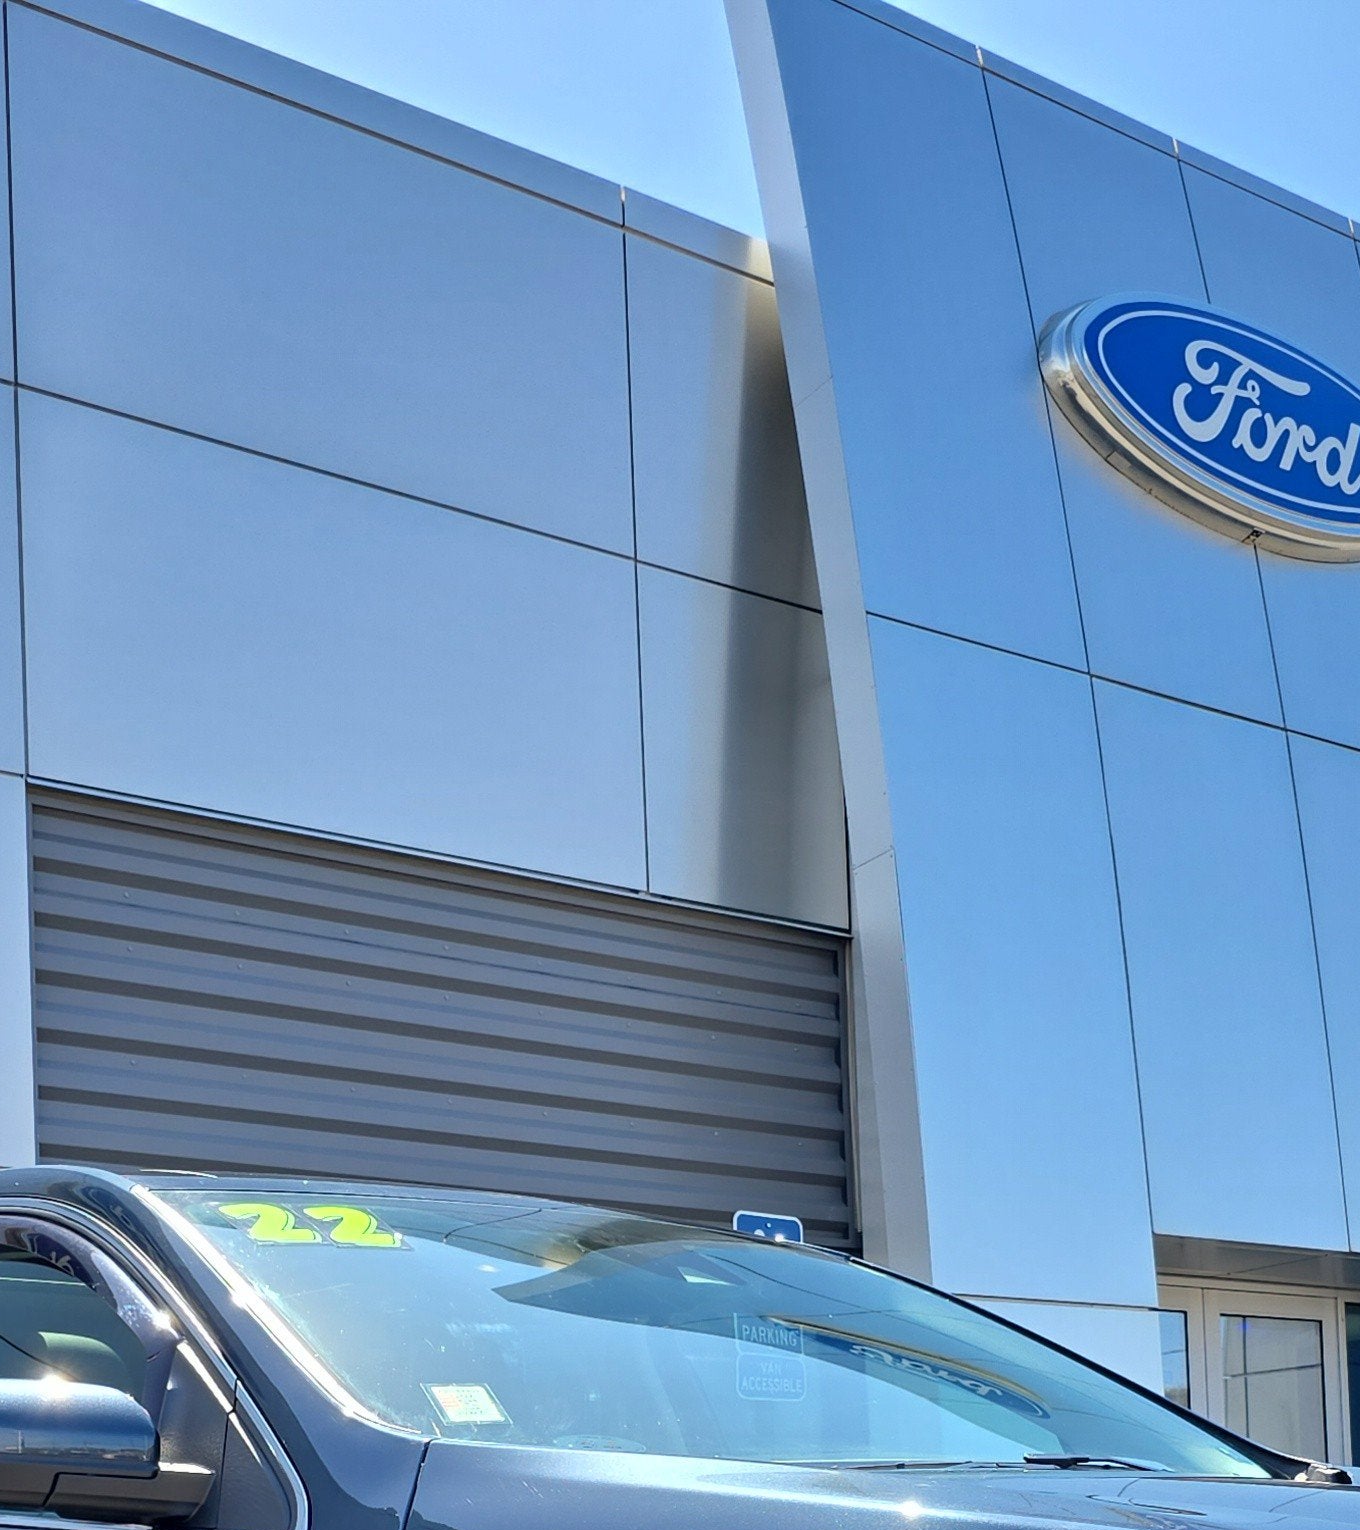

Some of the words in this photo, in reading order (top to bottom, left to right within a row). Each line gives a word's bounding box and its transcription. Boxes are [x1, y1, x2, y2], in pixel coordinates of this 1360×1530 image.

[218, 1203, 402, 1247] 22
[741, 1324, 799, 1347] PARKING
[760, 1362, 782, 1376] VAN
[741, 1377, 803, 1394] ACCESSIBLE
